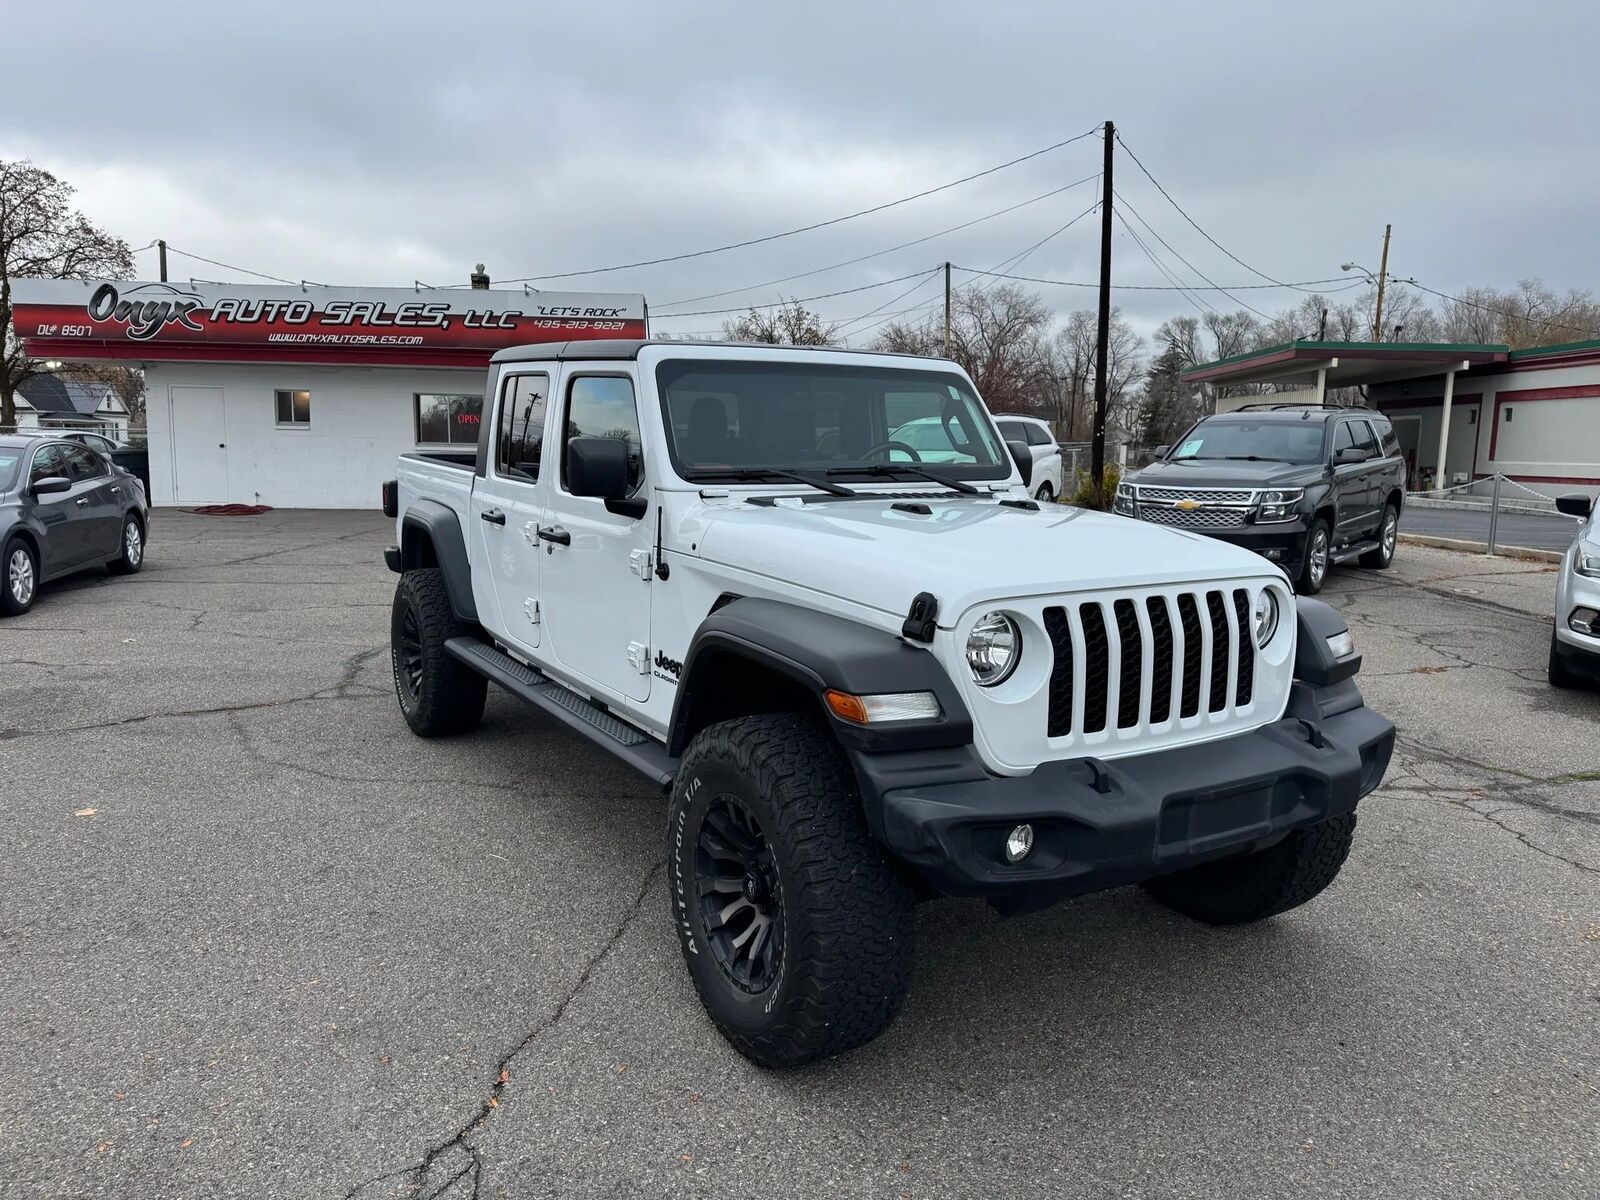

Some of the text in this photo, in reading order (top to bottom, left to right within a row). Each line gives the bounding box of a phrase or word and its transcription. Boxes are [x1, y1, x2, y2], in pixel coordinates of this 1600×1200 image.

[87, 283, 523, 340] Onyx AUTO SALES, LLC
[37, 324, 92, 336] DL# 8507
[534, 320, 625, 330] 435-213-9221
[457, 414, 480, 424] OPEN
[654, 650, 683, 679] Jeep
[683, 776, 702, 803] T/A
